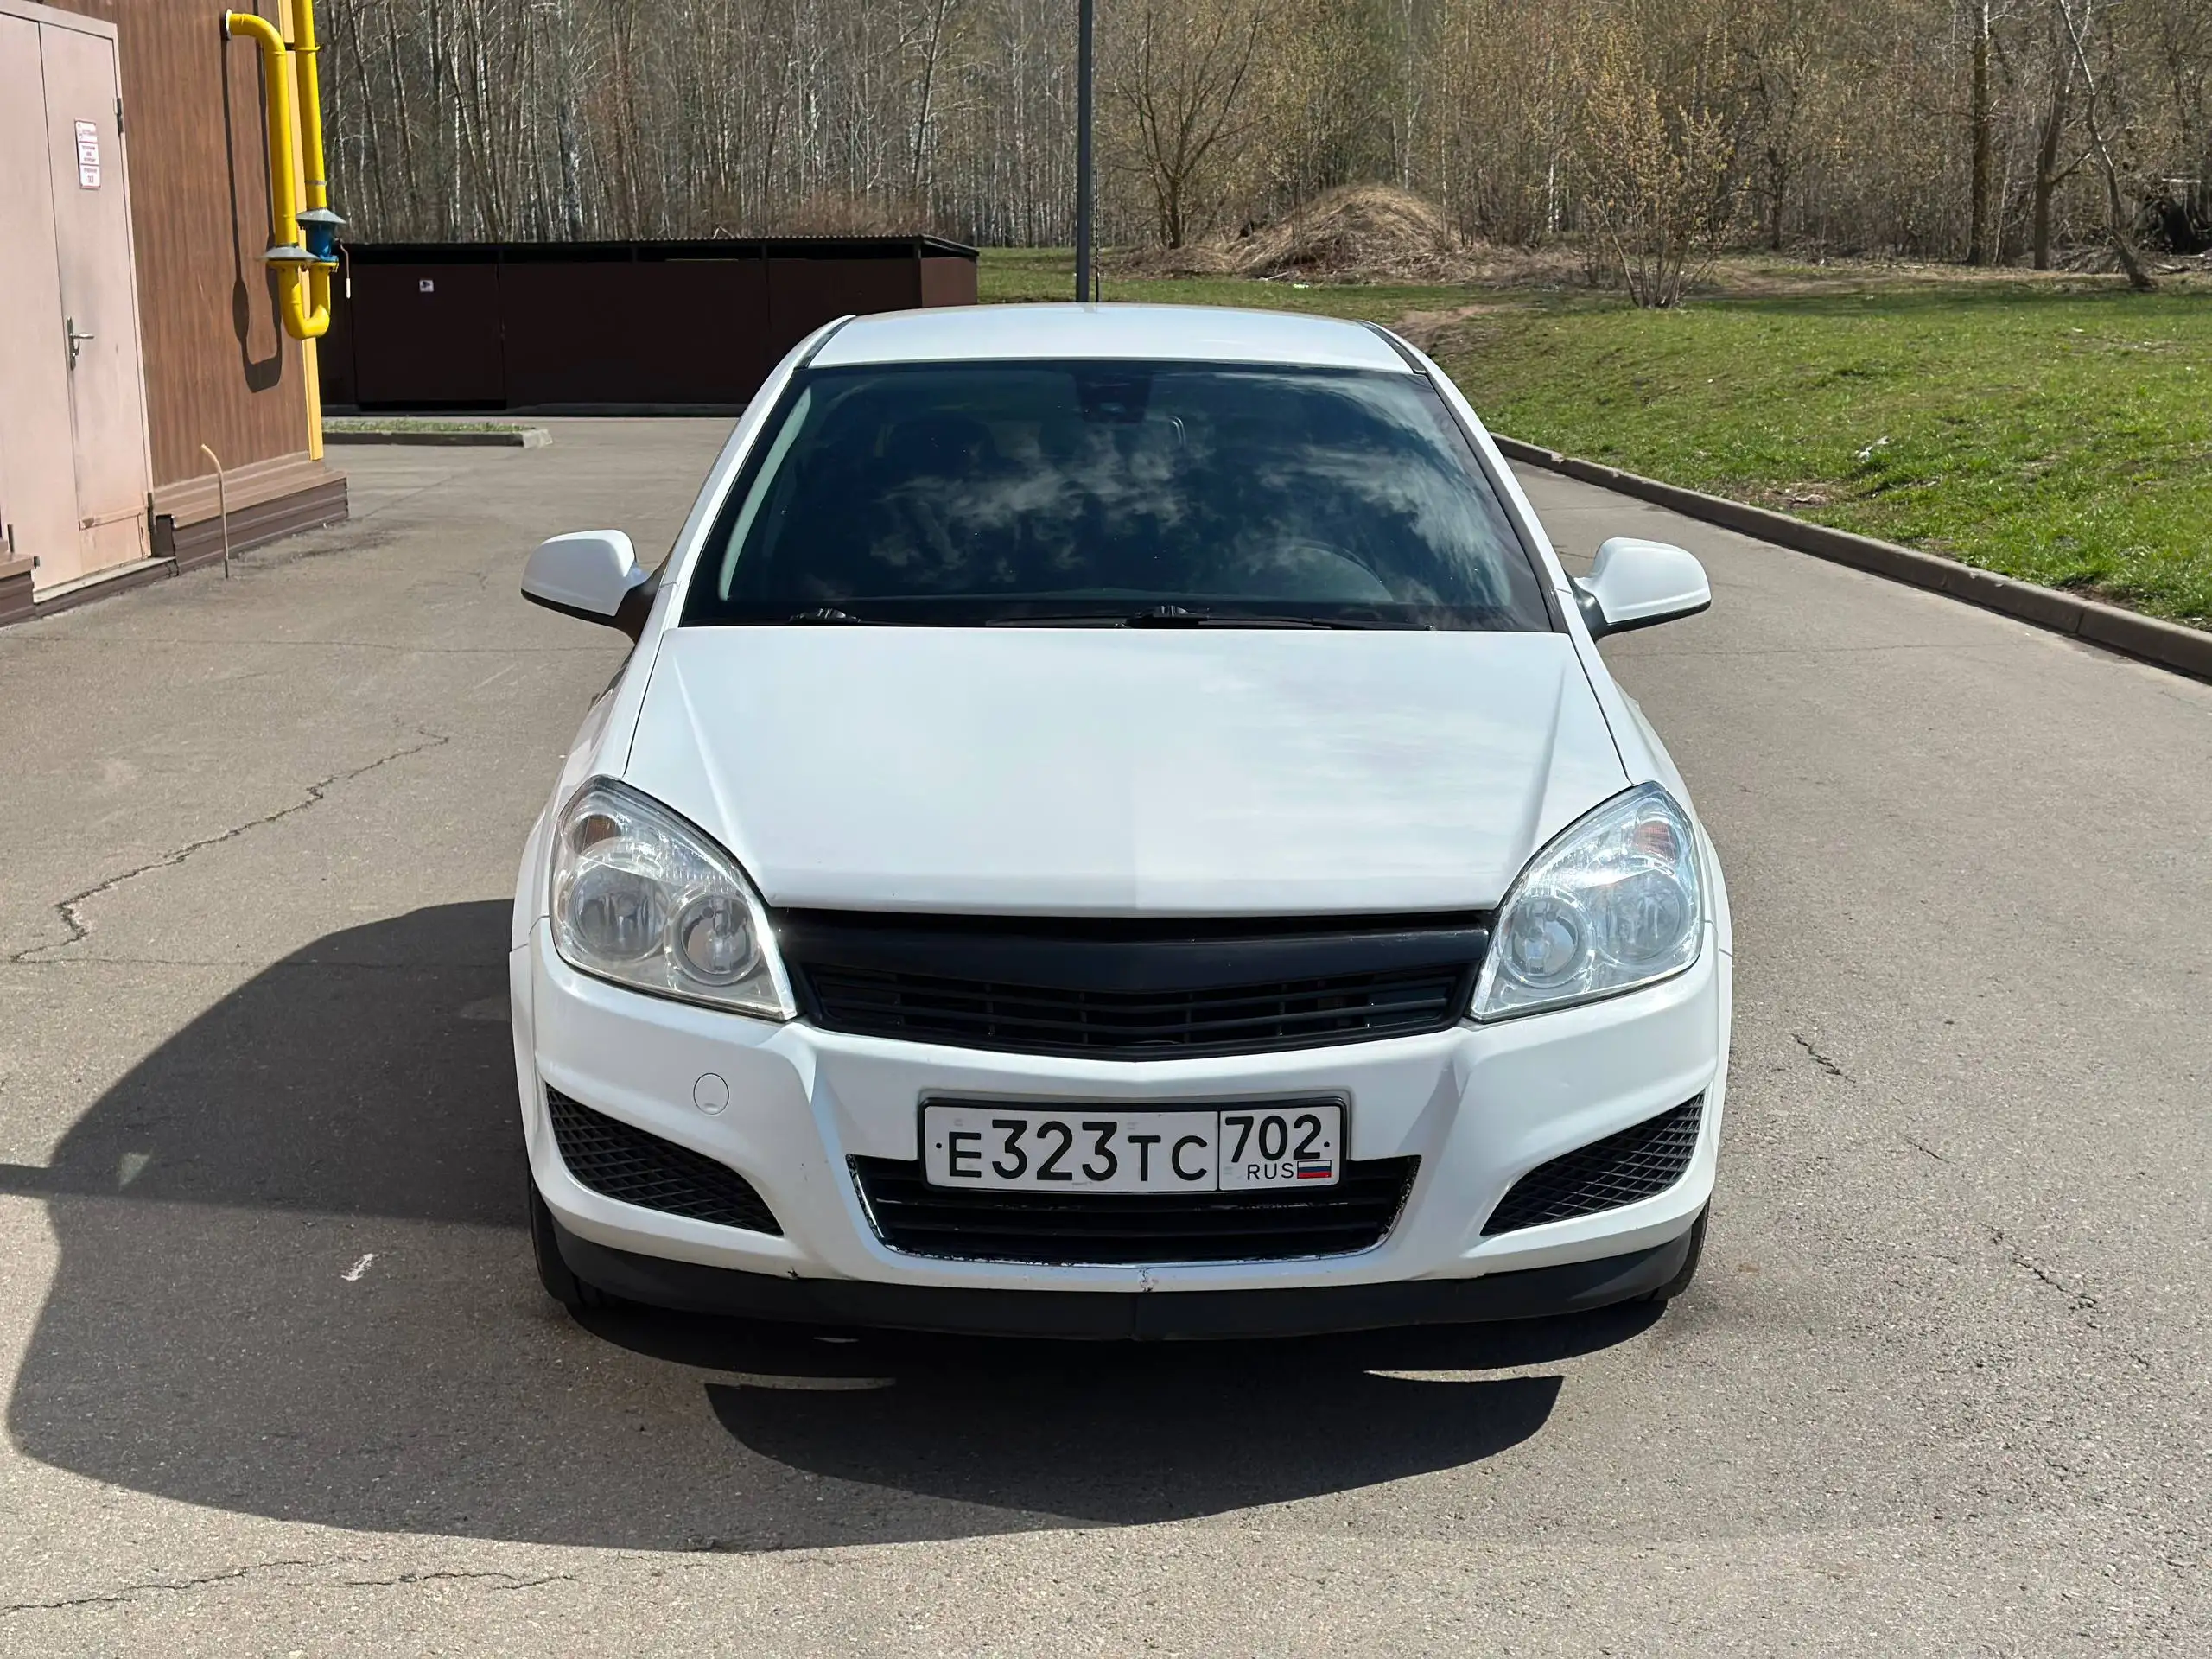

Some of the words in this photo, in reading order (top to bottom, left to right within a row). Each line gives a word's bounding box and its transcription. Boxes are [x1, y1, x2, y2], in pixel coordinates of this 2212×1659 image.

[948, 1119, 1209, 1182] E323TC
[1224, 1114, 1322, 1163] 702
[1247, 1162, 1294, 1180] RUS
